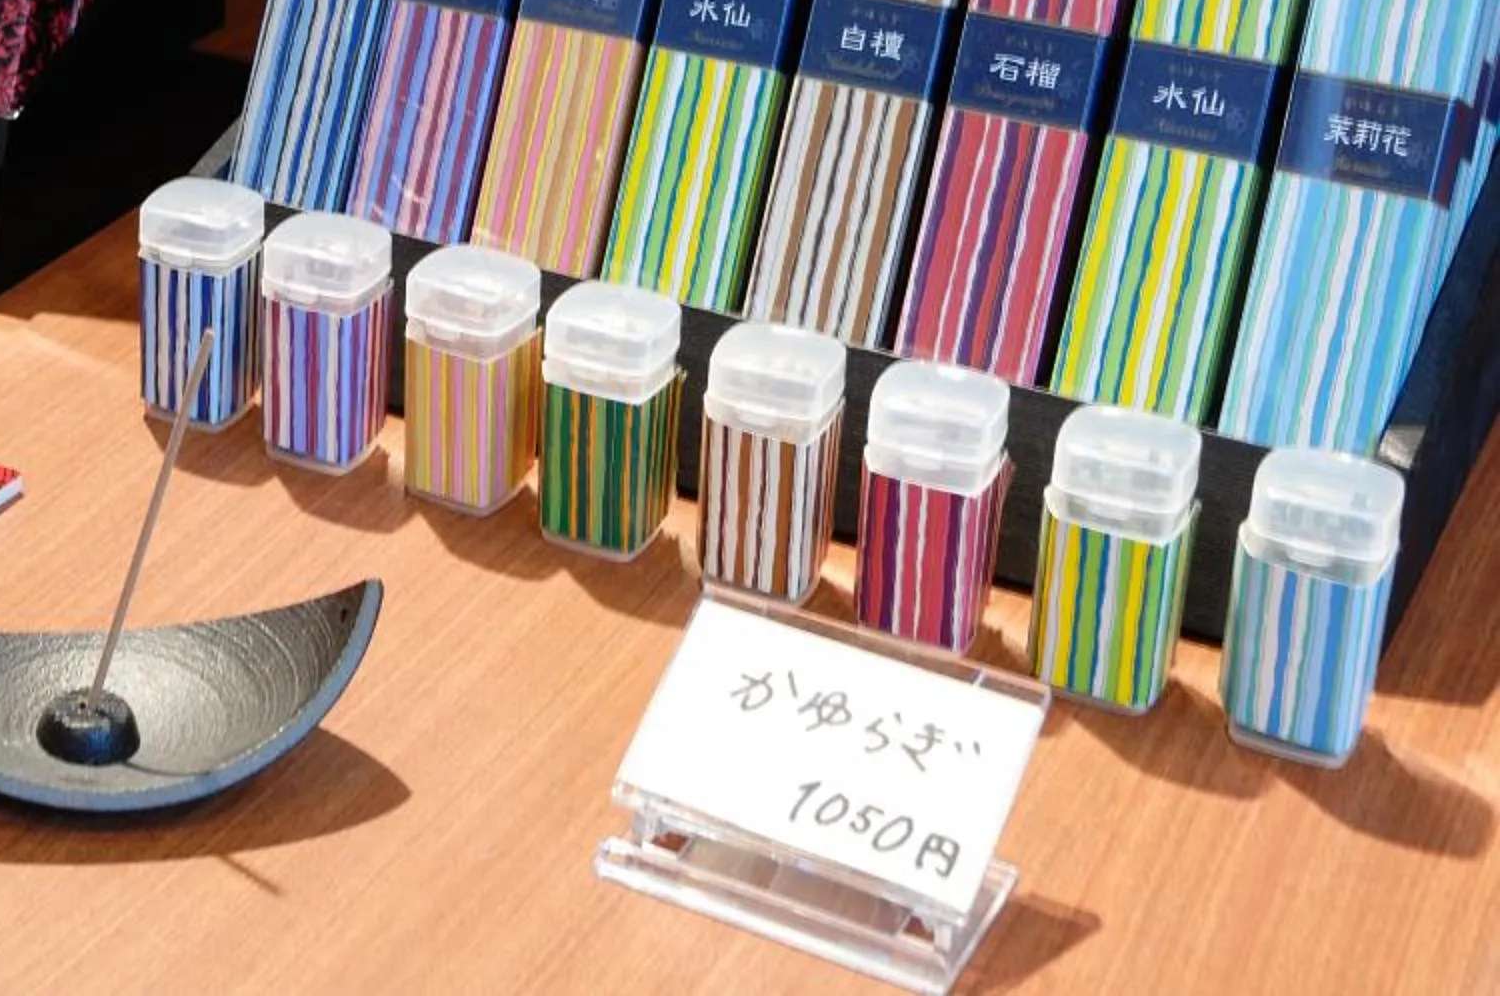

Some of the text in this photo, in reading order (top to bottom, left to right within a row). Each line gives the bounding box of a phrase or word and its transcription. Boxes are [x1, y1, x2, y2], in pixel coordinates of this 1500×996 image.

[839, 24, 906, 62] 白檀
[989, 53, 1062, 89] 石榴
[1152, 80, 1227, 118] 水仙
[1322, 114, 1415, 158] 茉莉花
[730, 669, 982, 773] かゆらぎ
[788, 781, 962, 878] 1050円
